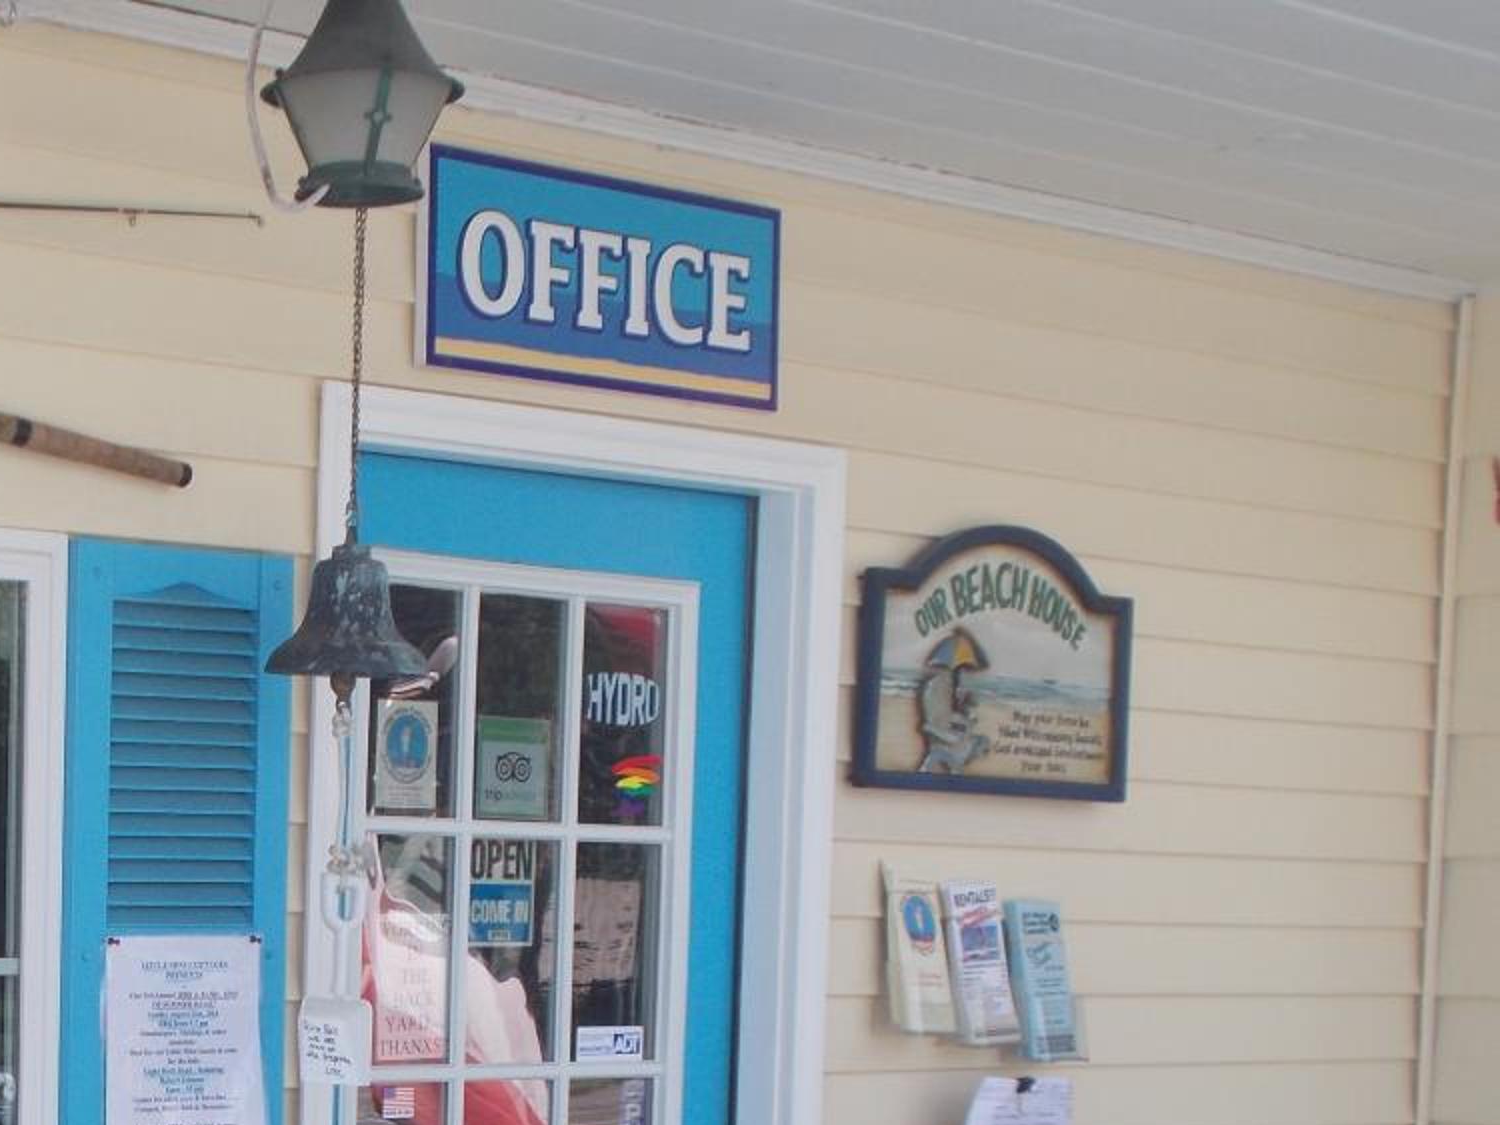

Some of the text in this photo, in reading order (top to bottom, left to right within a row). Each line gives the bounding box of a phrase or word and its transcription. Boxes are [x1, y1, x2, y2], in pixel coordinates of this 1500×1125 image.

[458, 208, 752, 353] OFFICE
[914, 562, 1086, 651] OUR BEACH HOUSE
[586, 672, 660, 727] HYDRO
[471, 838, 533, 880] OPEN
[471, 900, 530, 923] COME IN
[614, 1034, 640, 1054] ADT
